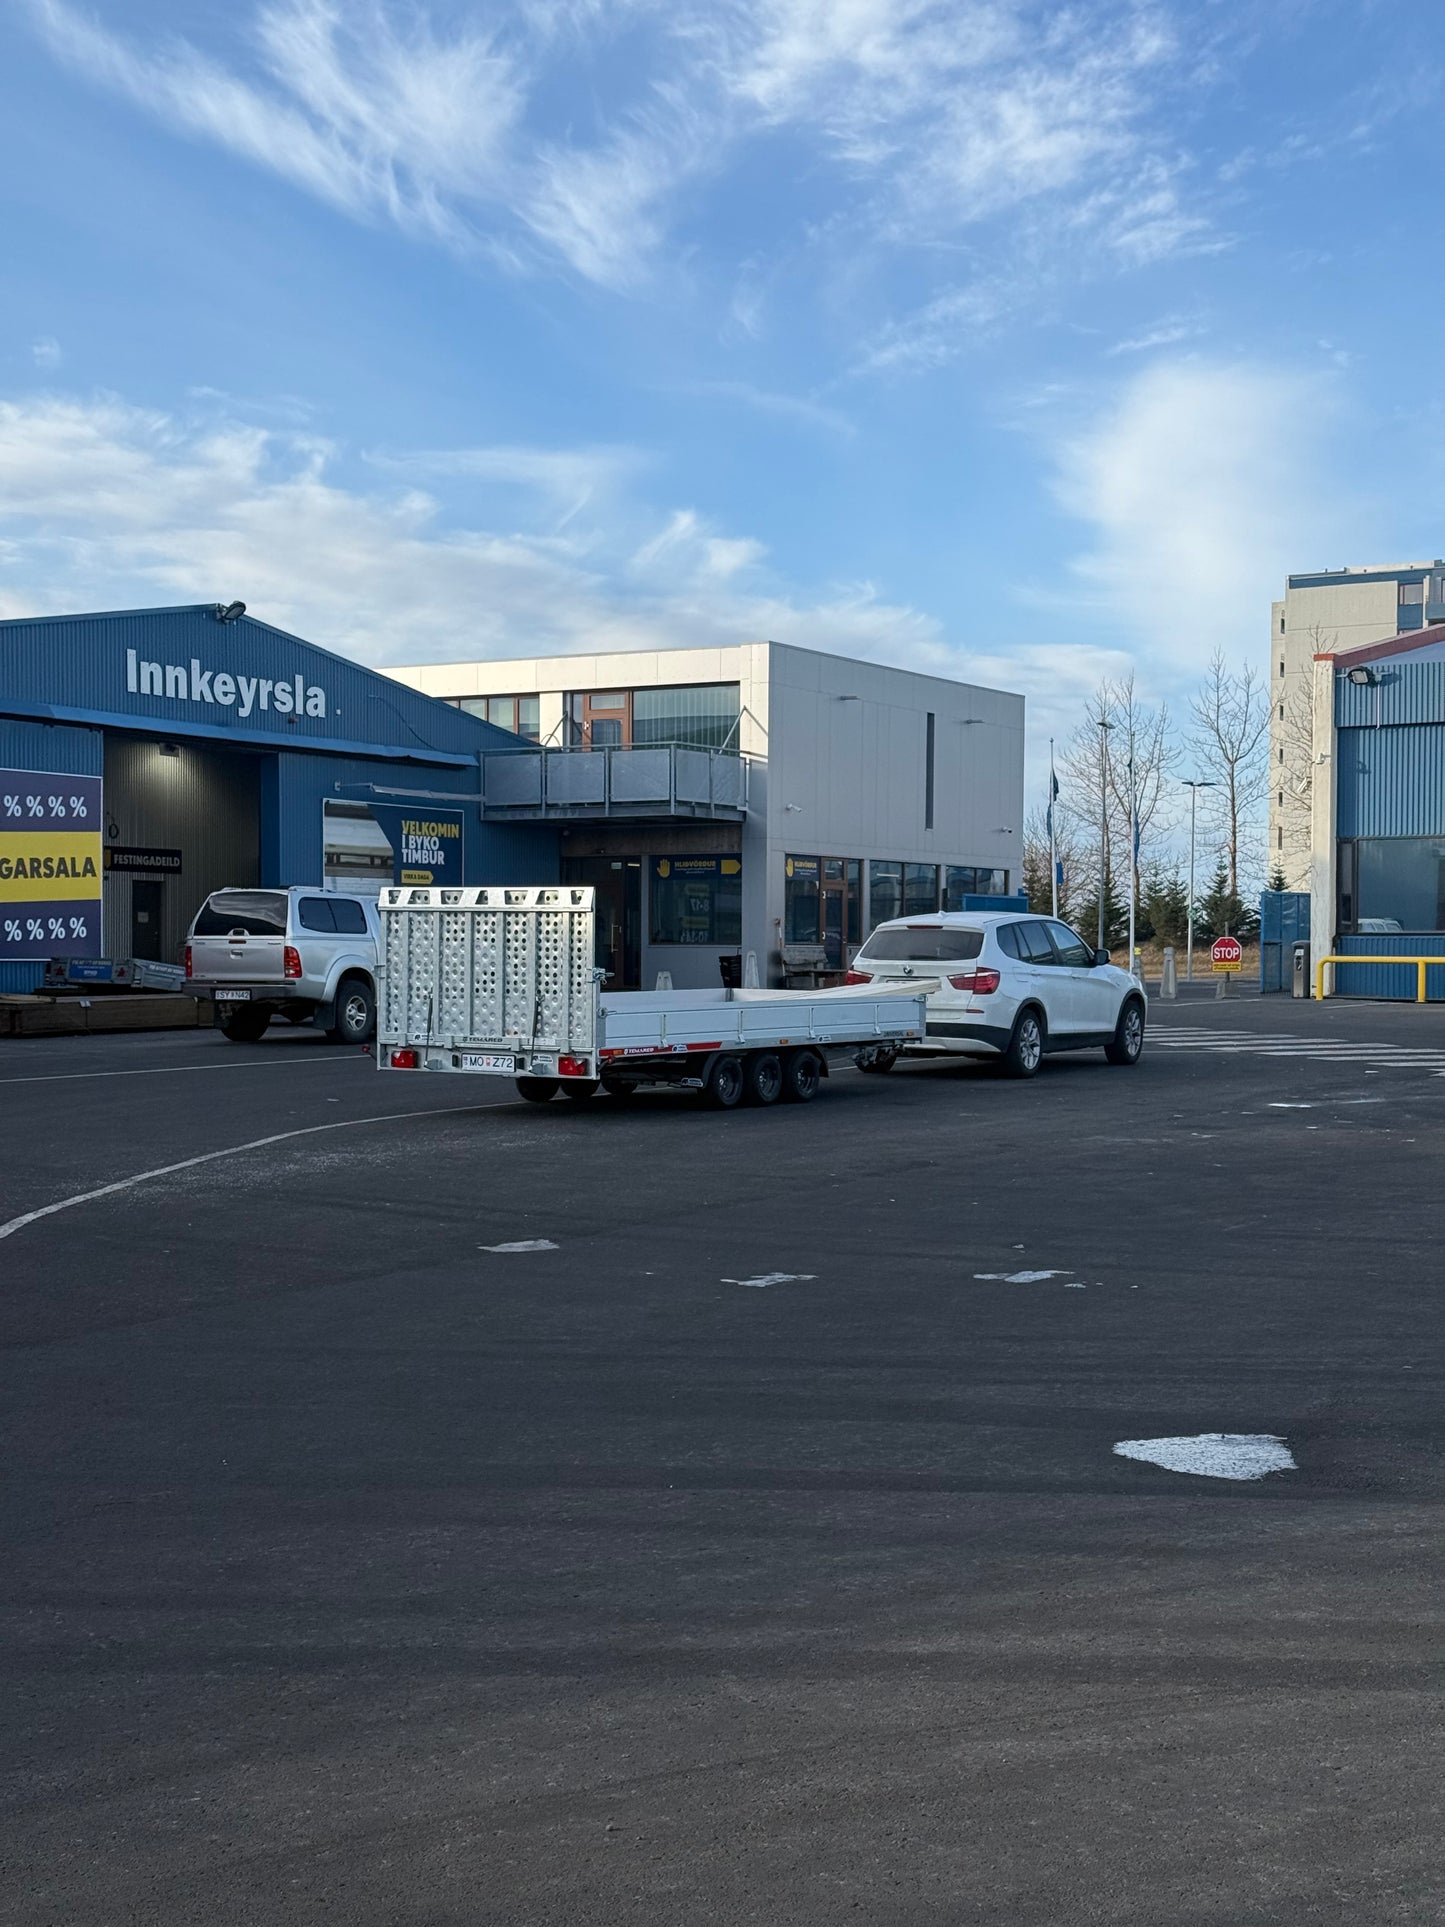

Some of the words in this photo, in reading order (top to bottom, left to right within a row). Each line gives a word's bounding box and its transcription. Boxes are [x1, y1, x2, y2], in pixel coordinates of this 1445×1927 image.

[127, 648, 326, 718] Innkeyrsla
[401, 820, 460, 838] VELKOMIN
[408, 834, 440, 850] BYKO
[113, 854, 180, 867] FESTINGADEILD
[401, 849, 445, 865] TIMBUR
[1213, 947, 1240, 959] STOP
[469, 1056, 484, 1067] MO
[492, 1057, 513, 1068] Z72
